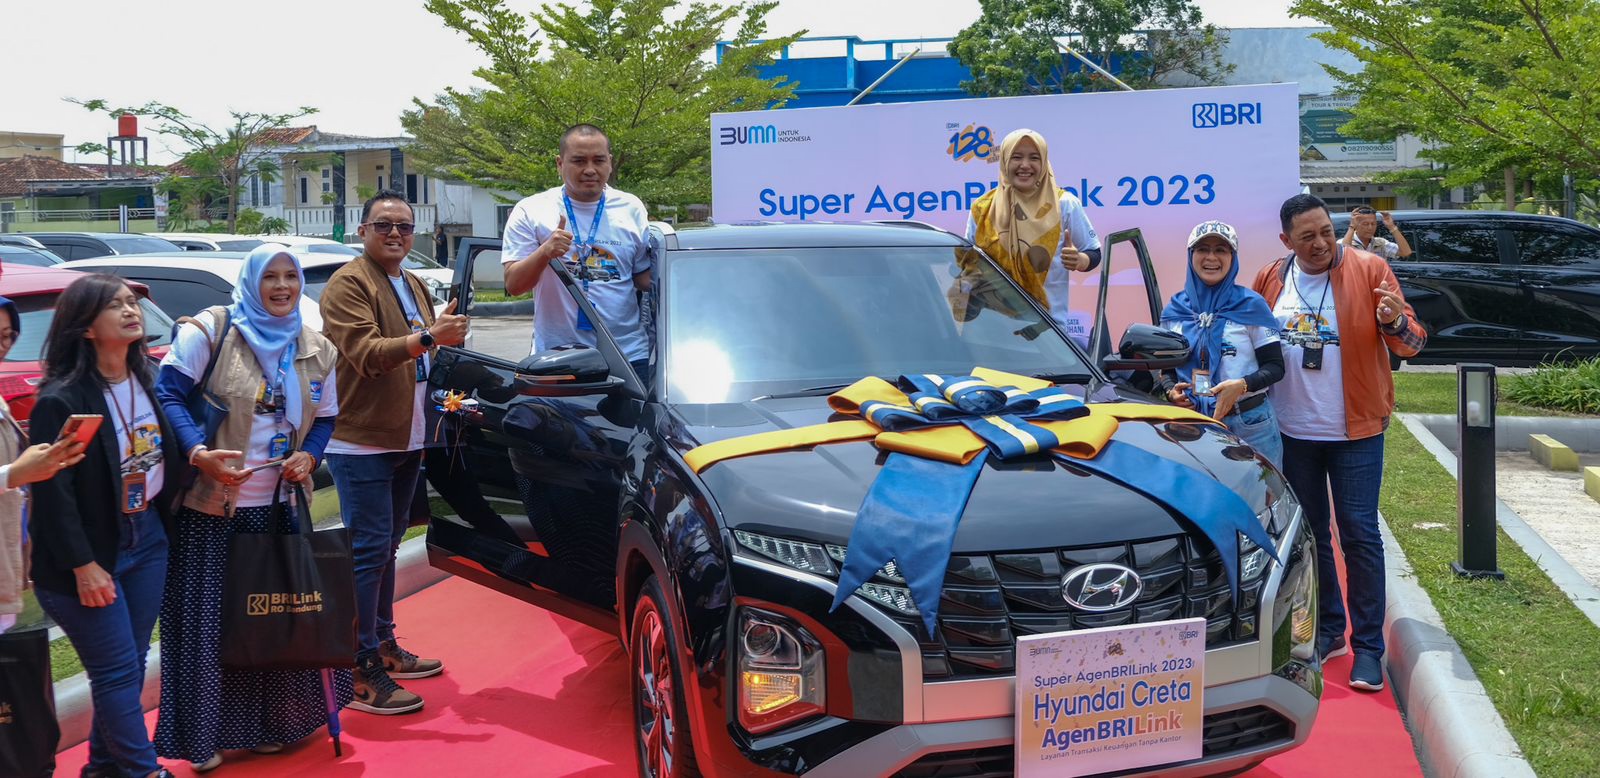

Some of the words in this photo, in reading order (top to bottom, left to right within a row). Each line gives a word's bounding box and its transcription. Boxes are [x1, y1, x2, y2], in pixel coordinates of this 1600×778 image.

[1220, 102, 1262, 125] BRI
[720, 124, 776, 145] BUMN
[777, 135, 812, 143] INDONESIA
[949, 126, 993, 161] 128
[759, 188, 855, 220] Super
[1117, 173, 1216, 206] 2023
[271, 590, 322, 605] BRILink
[271, 605, 285, 613] RO
[286, 604, 322, 613] Bandung
[1034, 674, 1072, 689] Super
[1075, 662, 1157, 684] AgenBRILink
[1161, 657, 1193, 672] 2023
[1033, 683, 1125, 724] Hyundai
[1131, 679, 1192, 707] Creta
[1041, 710, 1182, 751] AgenBRILink
[1040, 751, 1070, 761] Layanan
[1071, 745, 1101, 756] Transaksi
[1103, 742, 1137, 751] Keuangan
[1138, 738, 1158, 747] Tanpa
[1159, 735, 1182, 743] Kantor
